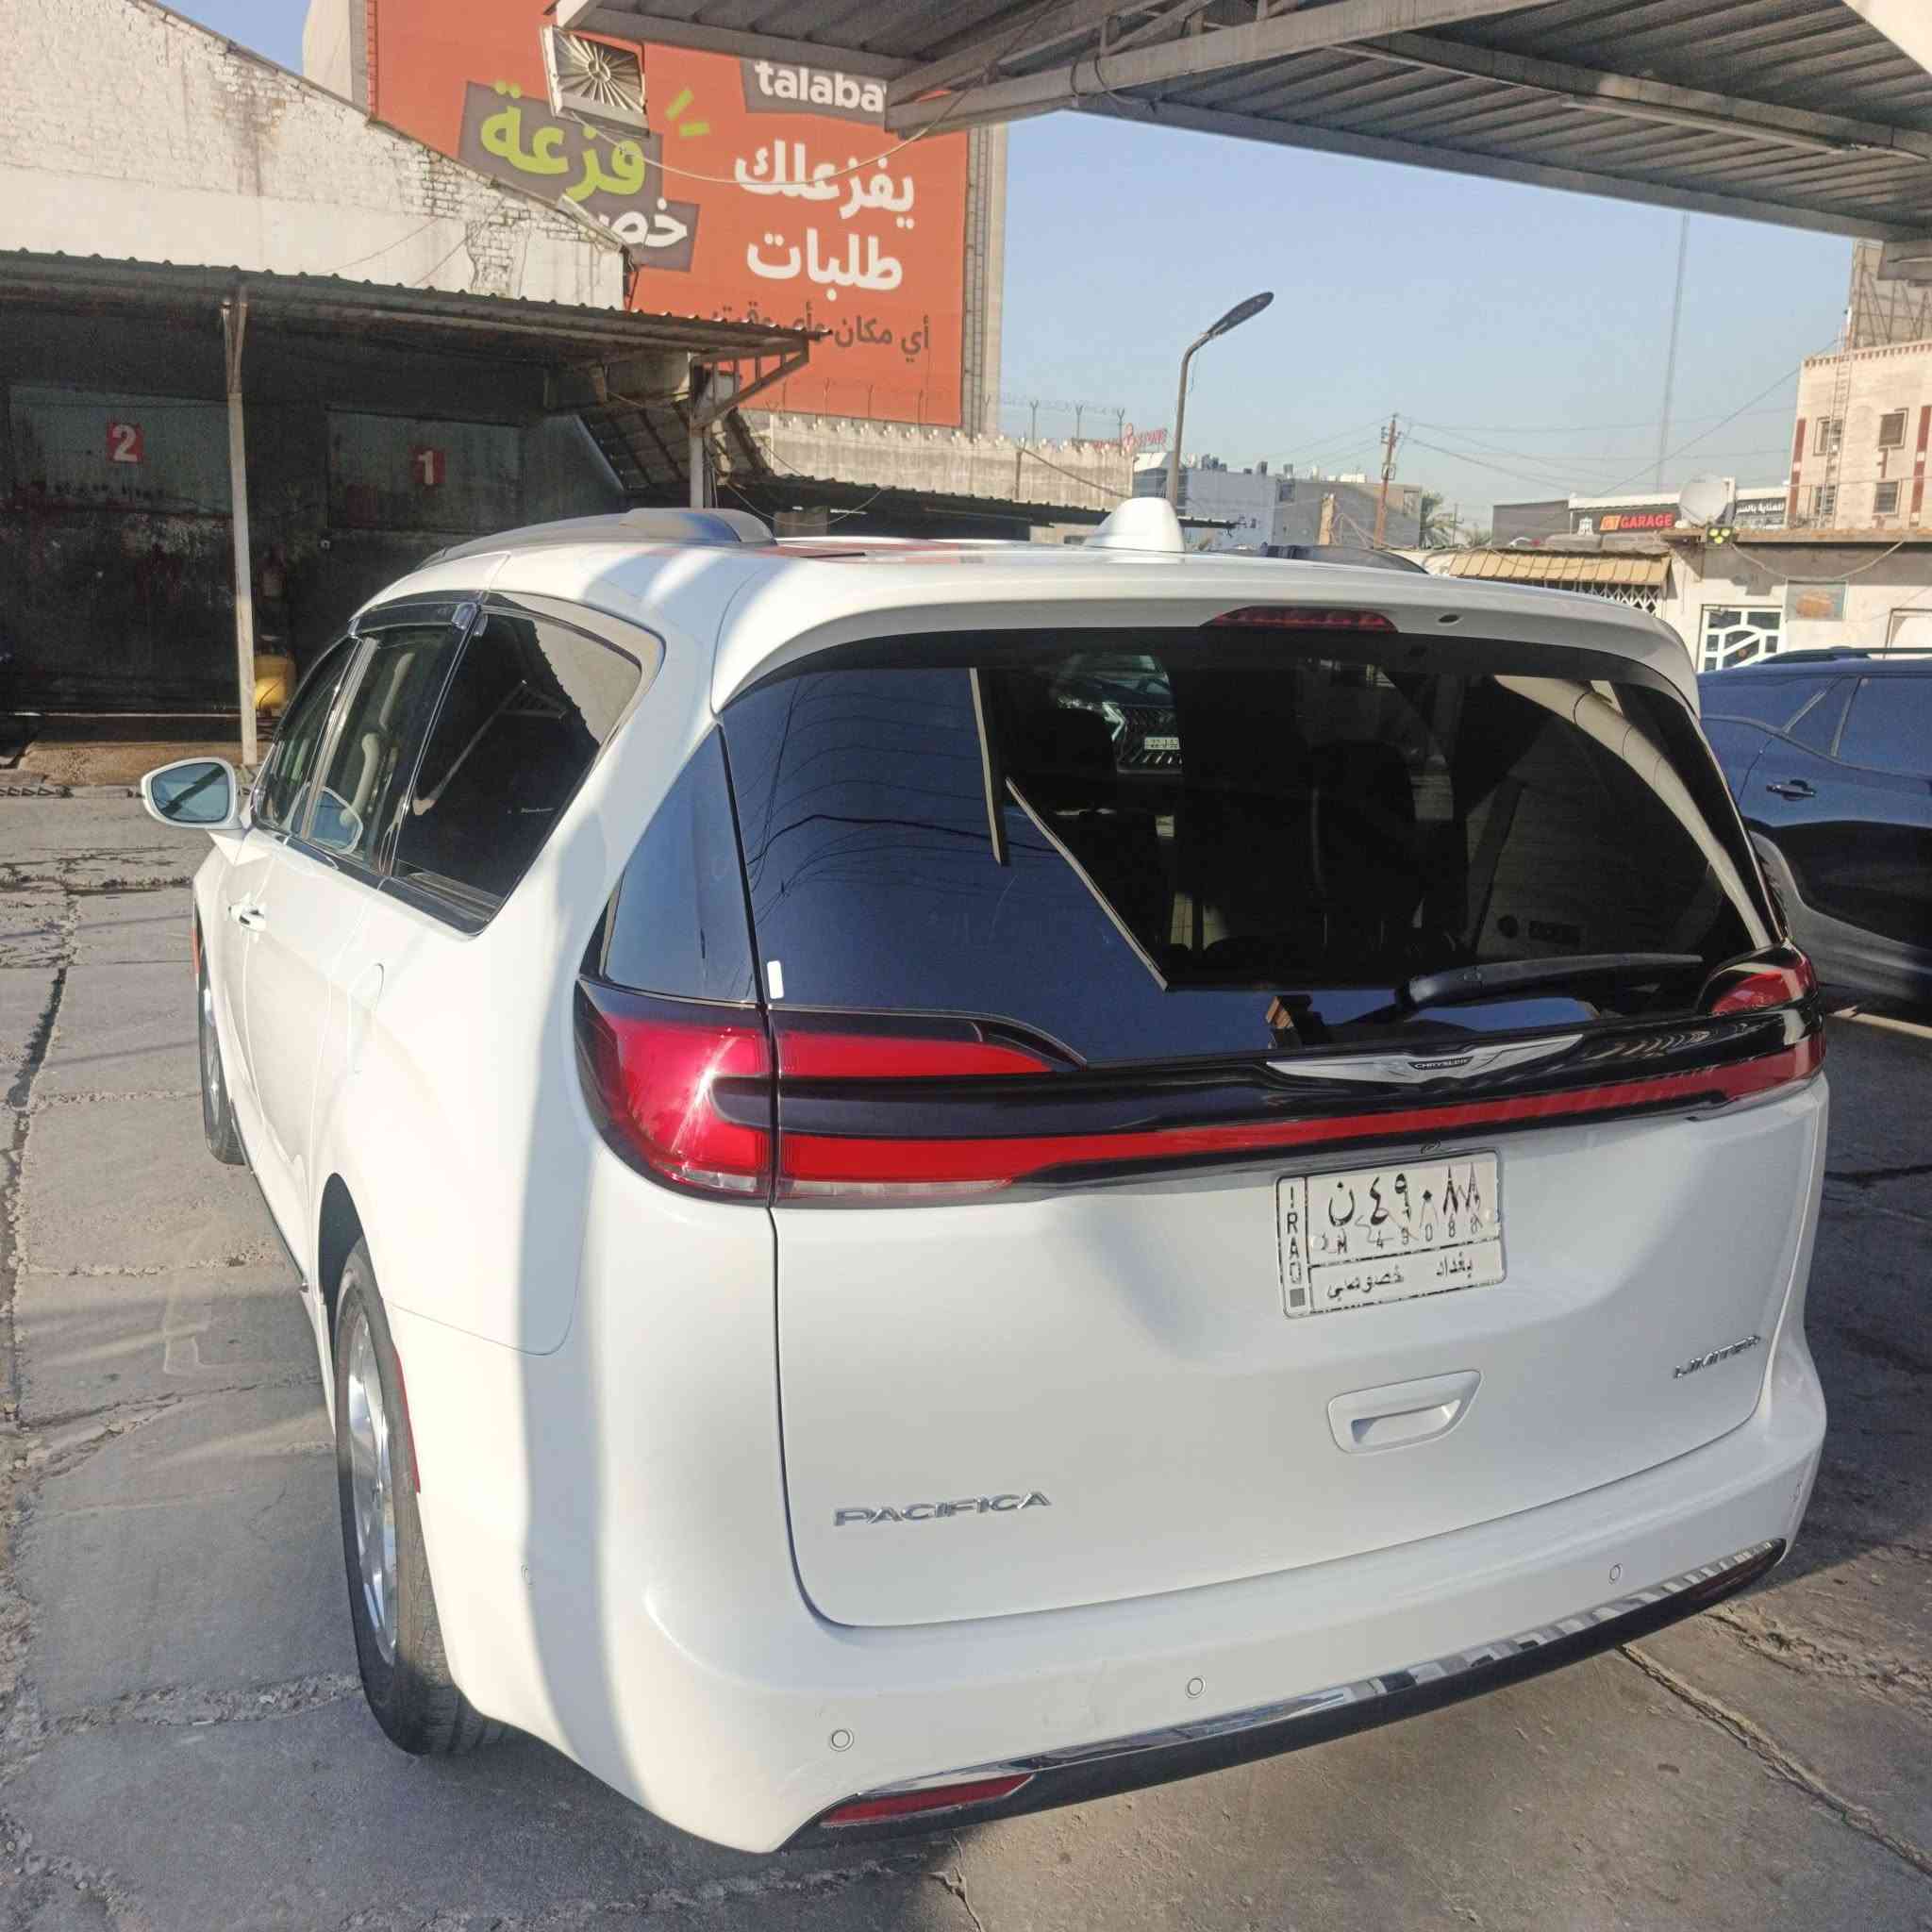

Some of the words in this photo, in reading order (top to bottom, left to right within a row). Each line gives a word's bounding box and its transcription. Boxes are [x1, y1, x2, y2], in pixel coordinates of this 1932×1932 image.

[755, 60, 888, 112] talaba
[480, 81, 645, 202] فزعة
[735, 140, 914, 228] يفزعلك
[747, 227, 903, 301] طلبات
[834, 316, 892, 347] مكان
[900, 315, 929, 363] أي
[112, 425, 138, 462] 2
[418, 450, 434, 485] 1
[1621, 514, 1674, 528] GARAGE
[1326, 1264, 1405, 1302] خصوصي
[834, 1491, 1051, 1526] PACIFICA
